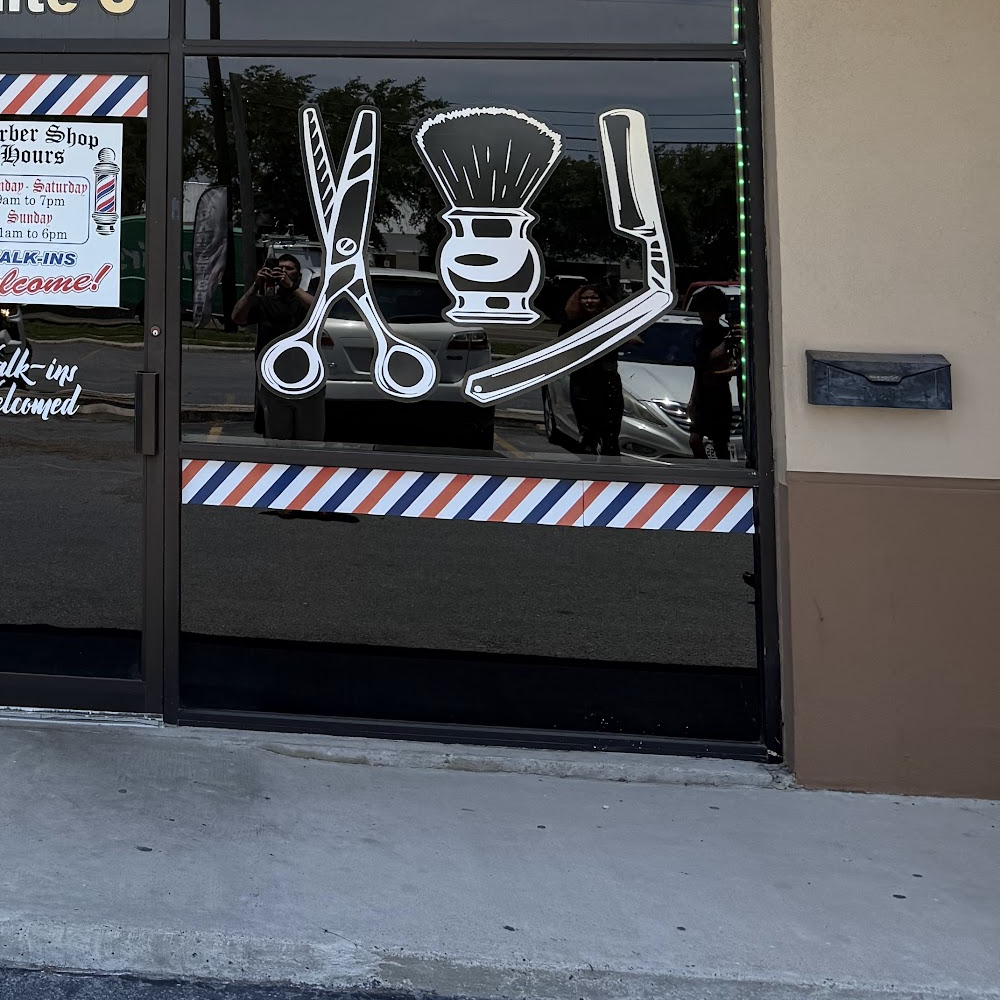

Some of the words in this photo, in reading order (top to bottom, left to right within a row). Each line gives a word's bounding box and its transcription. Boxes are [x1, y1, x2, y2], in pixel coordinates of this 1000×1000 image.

[45, 124, 99, 150] Shop
[0, 143, 64, 167] Hours
[32, 178, 88, 197] Saturday
[25, 195, 36, 206] to
[39, 194, 66, 208] 7pm
[7, 209, 53, 227] Sunday
[27, 228, 39, 239] to
[42, 228, 68, 242] 6pm
